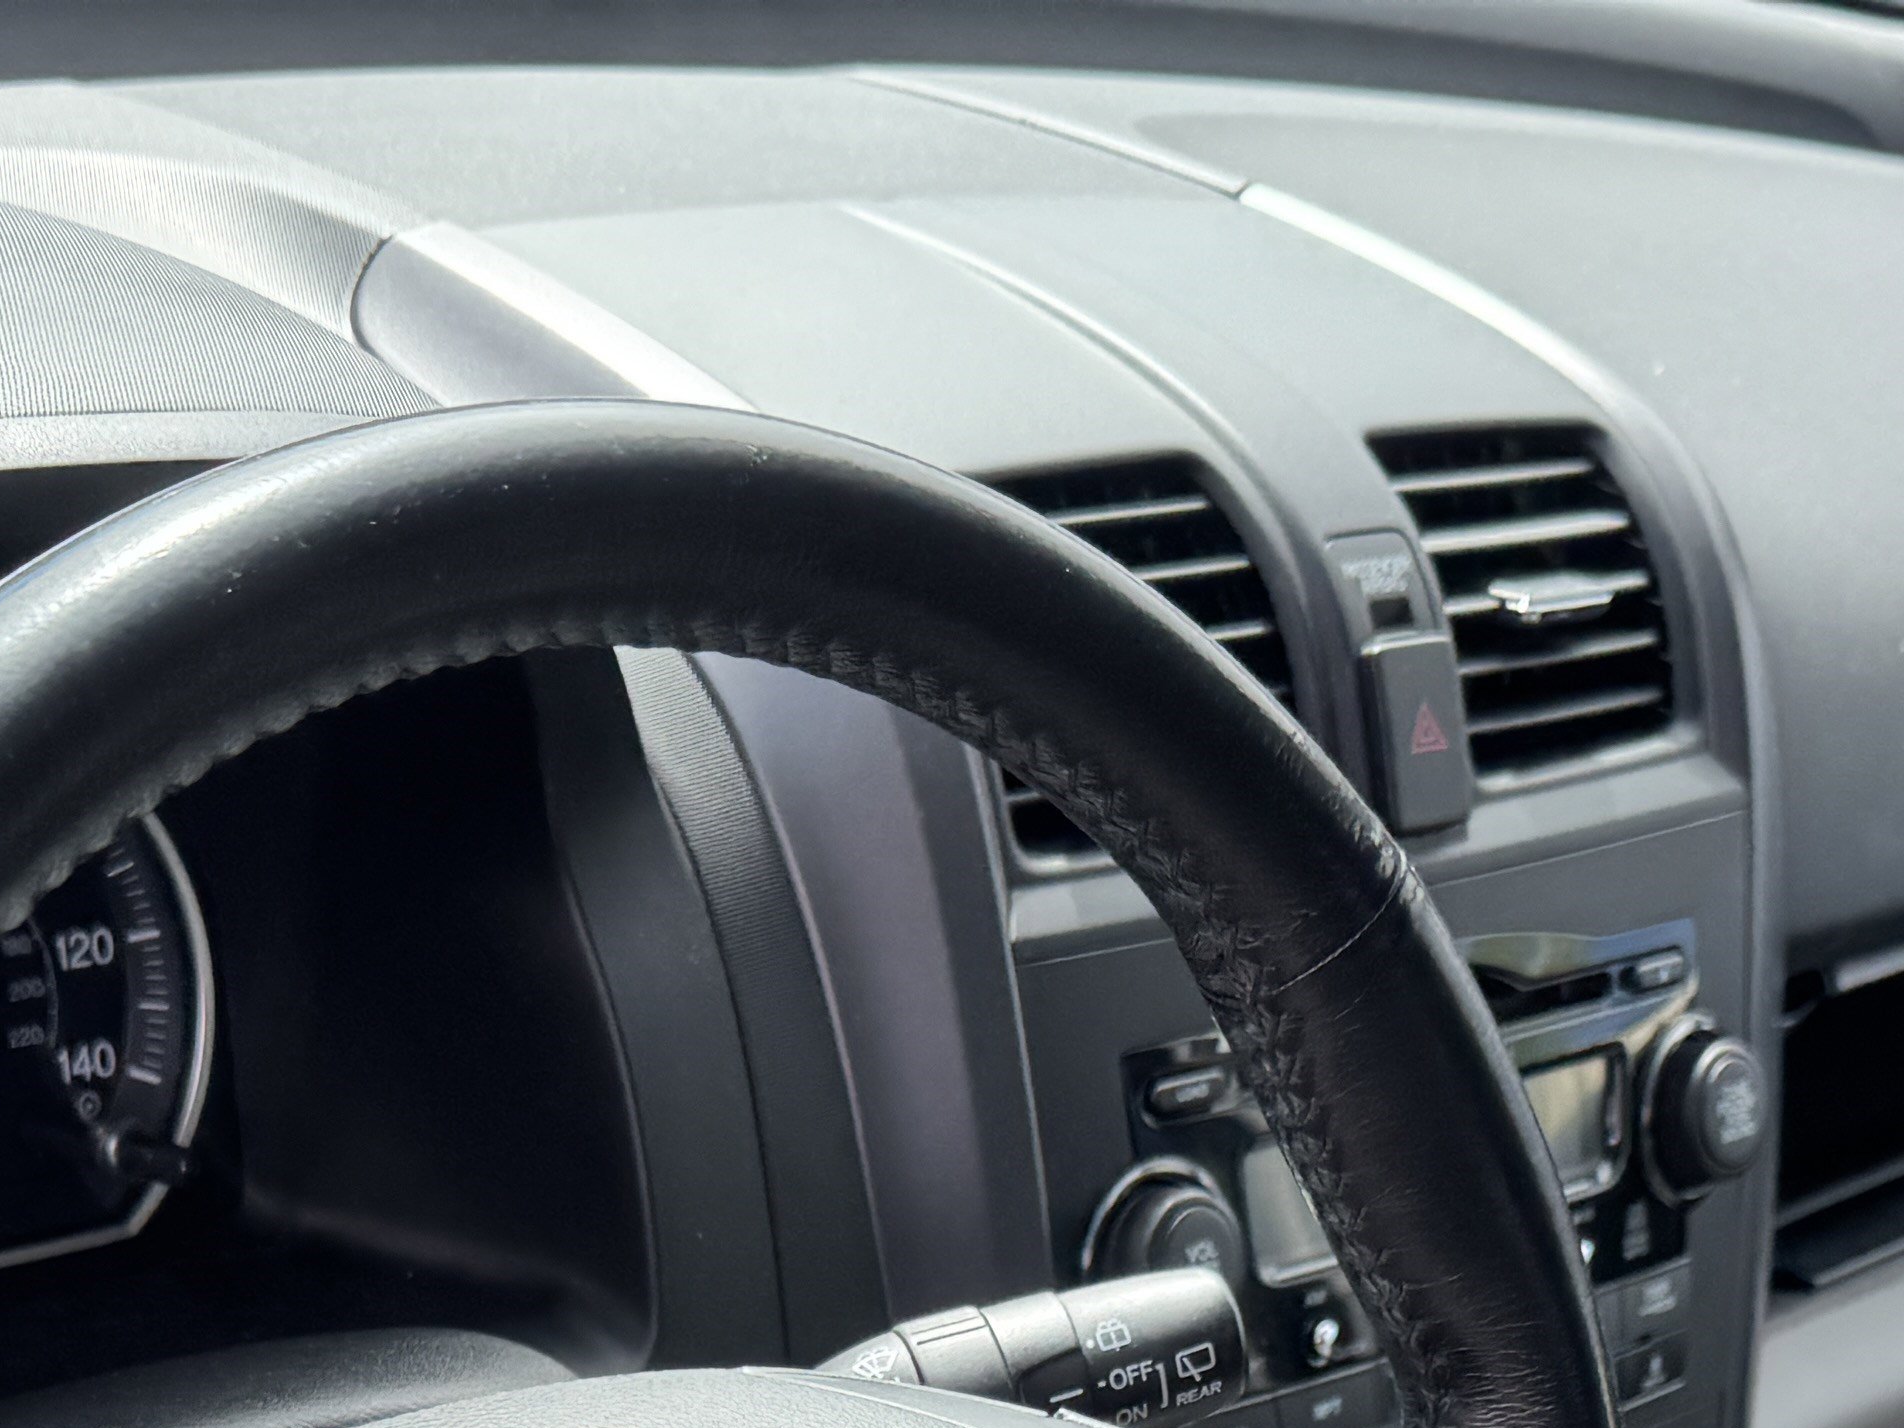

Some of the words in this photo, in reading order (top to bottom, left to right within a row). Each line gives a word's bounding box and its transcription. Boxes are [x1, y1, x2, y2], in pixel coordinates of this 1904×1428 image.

[55, 927, 115, 972] 120
[7, 1022, 46, 1050] 220
[57, 1038, 117, 1086] 140
[1108, 1359, 1154, 1391] OFF
[1176, 1380, 1223, 1407] REAR
[1116, 1403, 1148, 1427] ON
